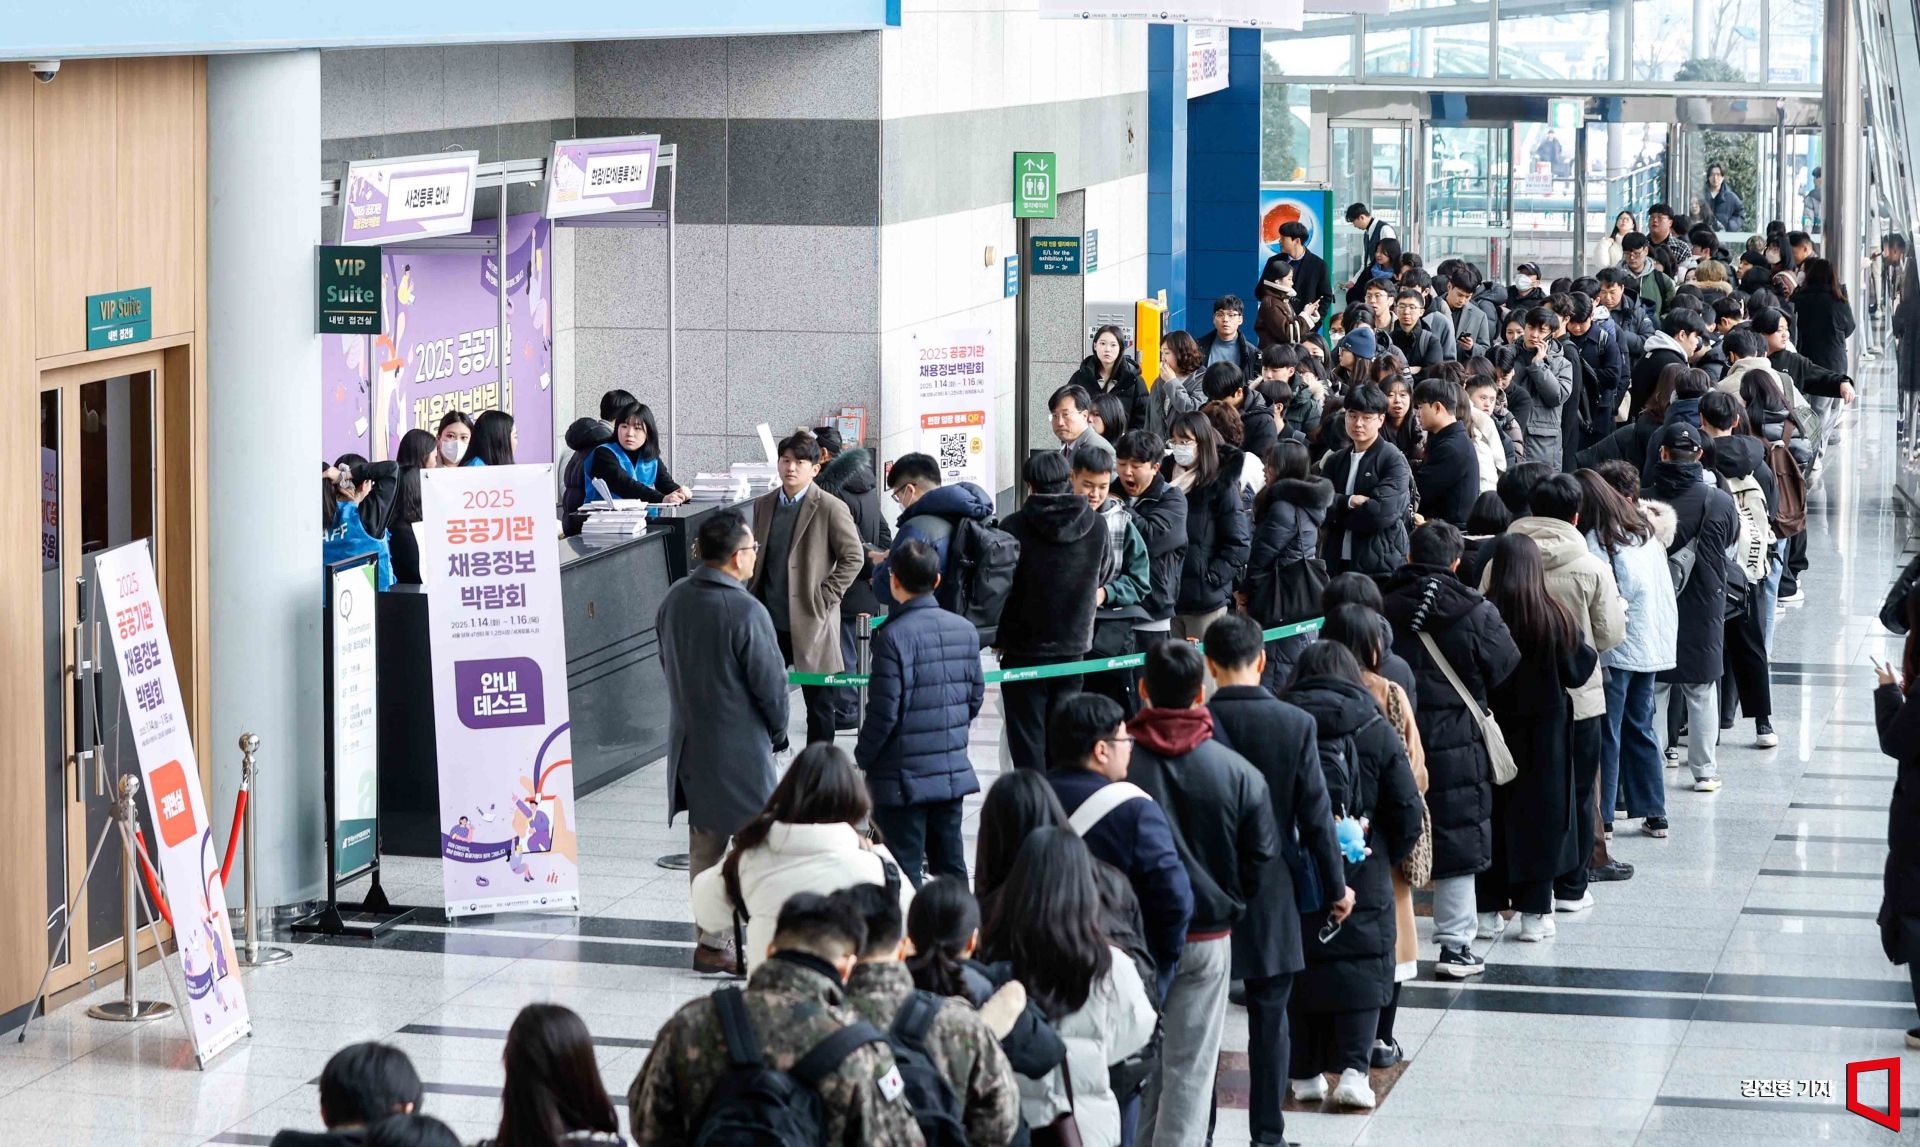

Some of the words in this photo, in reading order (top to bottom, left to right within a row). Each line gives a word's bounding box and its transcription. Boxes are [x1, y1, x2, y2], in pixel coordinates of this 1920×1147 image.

[591, 165, 629, 185] 현장/단체등록
[630, 164, 642, 181] 안내
[404, 187, 434, 208] 사전등록
[435, 185, 451, 206] 안내
[335, 259, 366, 276] VIP
[327, 284, 374, 303] Suite
[100, 299, 116, 321] VIP
[118, 297, 141, 318] Suite
[328, 315, 344, 325] 내빈
[348, 315, 372, 326] 접견실
[415, 337, 454, 384] 2025
[919, 347, 948, 361] 2025
[949, 344, 984, 359] 공공기관
[919, 361, 985, 378] 채용정보박람회
[462, 489, 515, 509] 2025
[446, 516, 535, 545] 공공기관
[448, 550, 536, 578] 채용정보
[116, 572, 140, 598] 2025
[461, 583, 526, 611] 박람회
[116, 600, 154, 640] 공공기관
[124, 638, 162, 677] 채용정보
[135, 677, 166, 712] 박람회
[480, 671, 517, 694] 안내
[473, 693, 528, 717] 데스크
